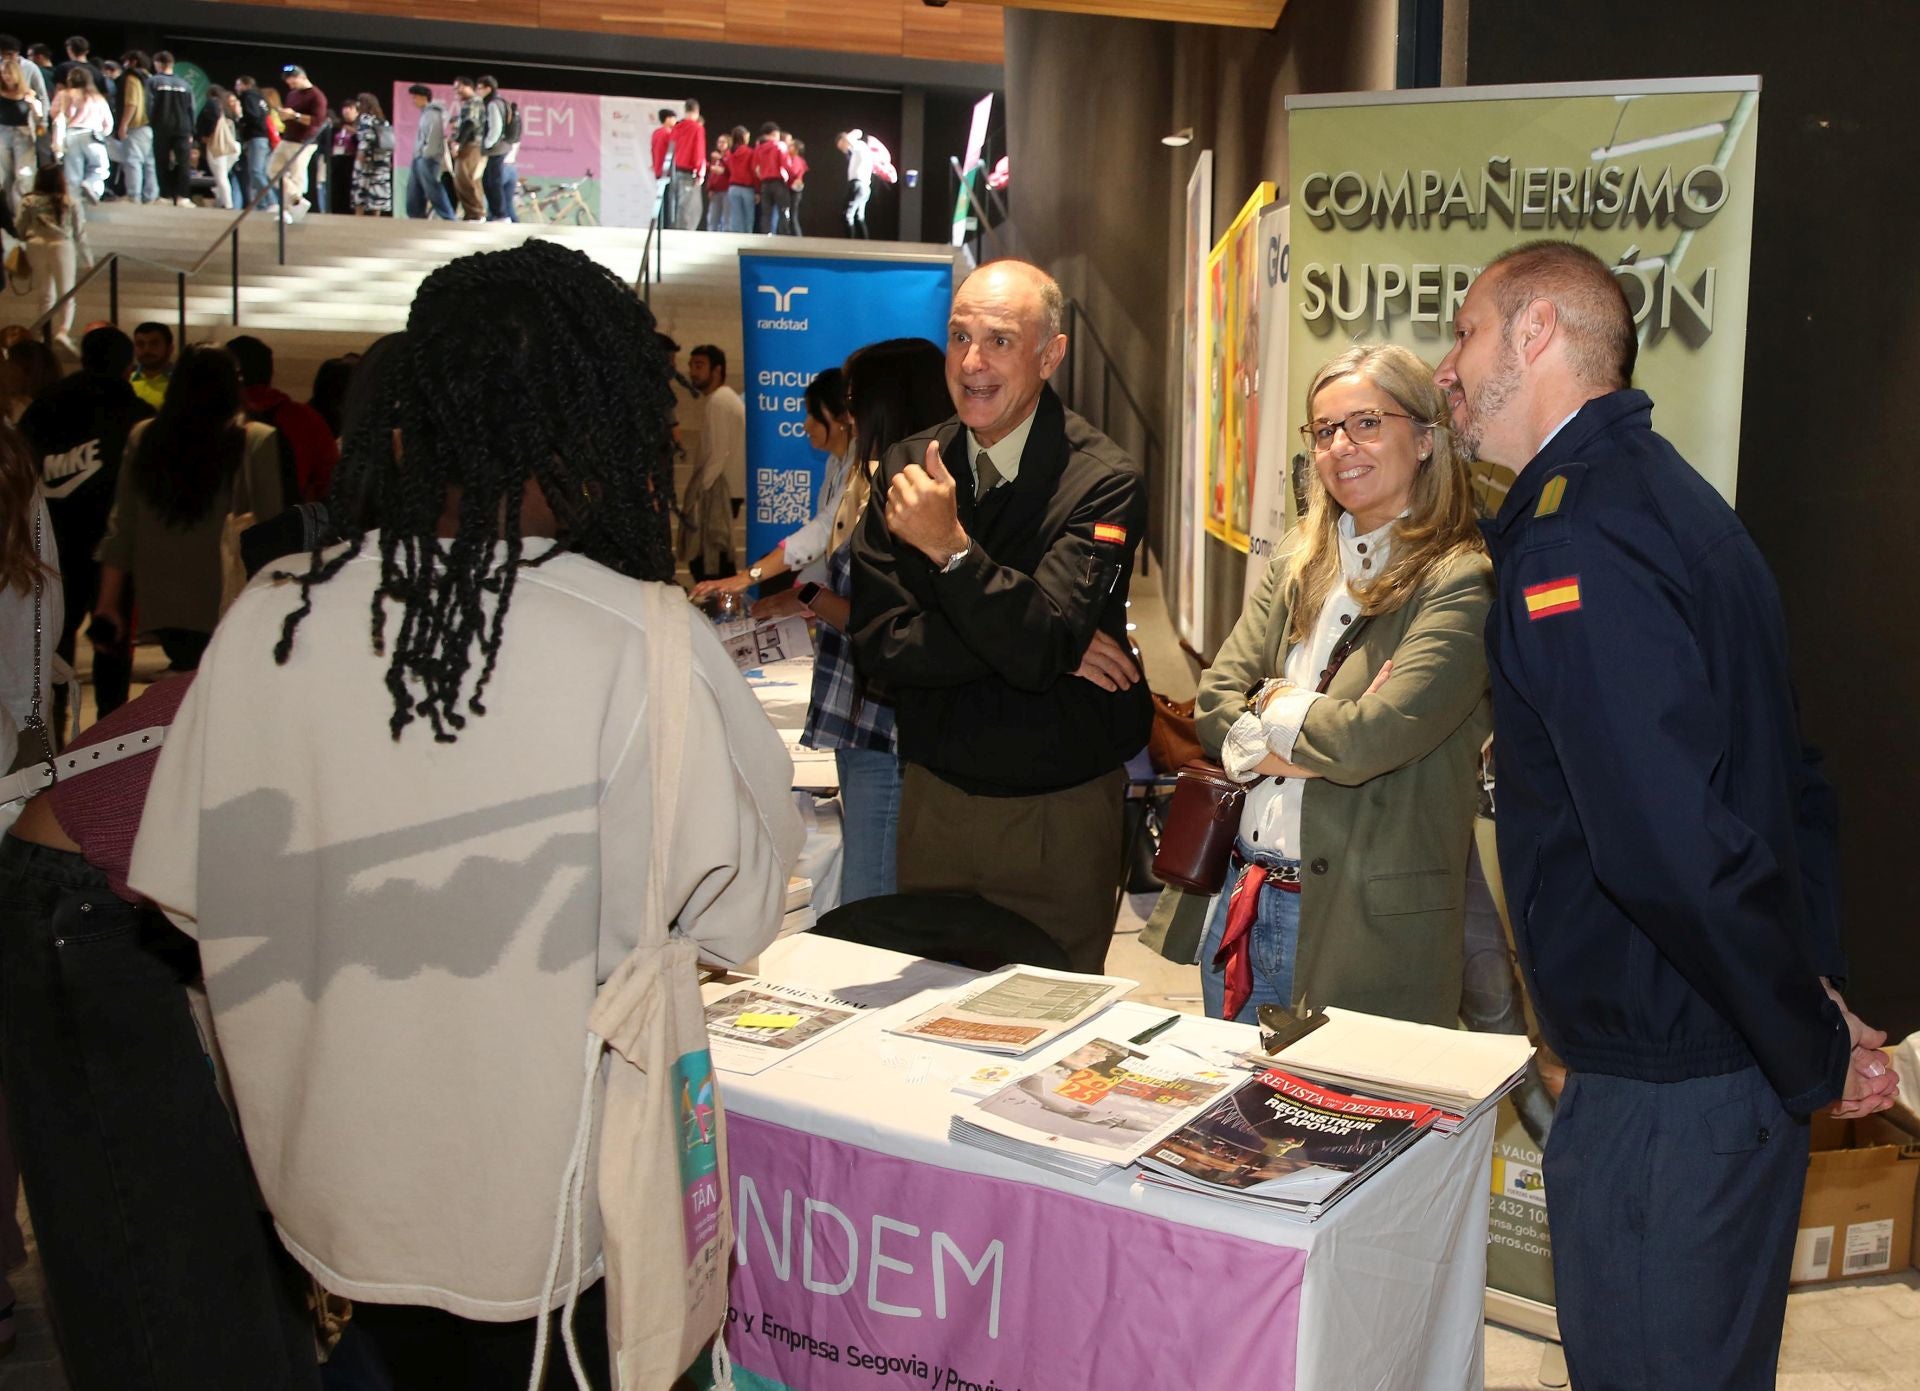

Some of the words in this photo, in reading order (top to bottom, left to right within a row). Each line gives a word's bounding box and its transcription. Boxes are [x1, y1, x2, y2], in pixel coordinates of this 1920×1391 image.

[1301, 155, 1731, 218] COMPAÑERISMO
[757, 317, 809, 331] randstad
[758, 393, 779, 411] tu
[43, 438, 101, 483] NIKE
[1259, 1072, 1324, 1106] REVISTA
[1341, 1102, 1415, 1120] DEFENSA
[1264, 1097, 1377, 1132] RECONSTRUIR
[1272, 1111, 1287, 1121] Y
[1284, 1117, 1352, 1136] APOYAR
[1498, 1200, 1524, 1218] 432
[737, 1174, 1005, 1340] NDEM
[744, 1313, 755, 1334] y
[761, 1312, 840, 1363] Empresa
[846, 1344, 928, 1380] Segovia
[931, 1366, 943, 1390] y
